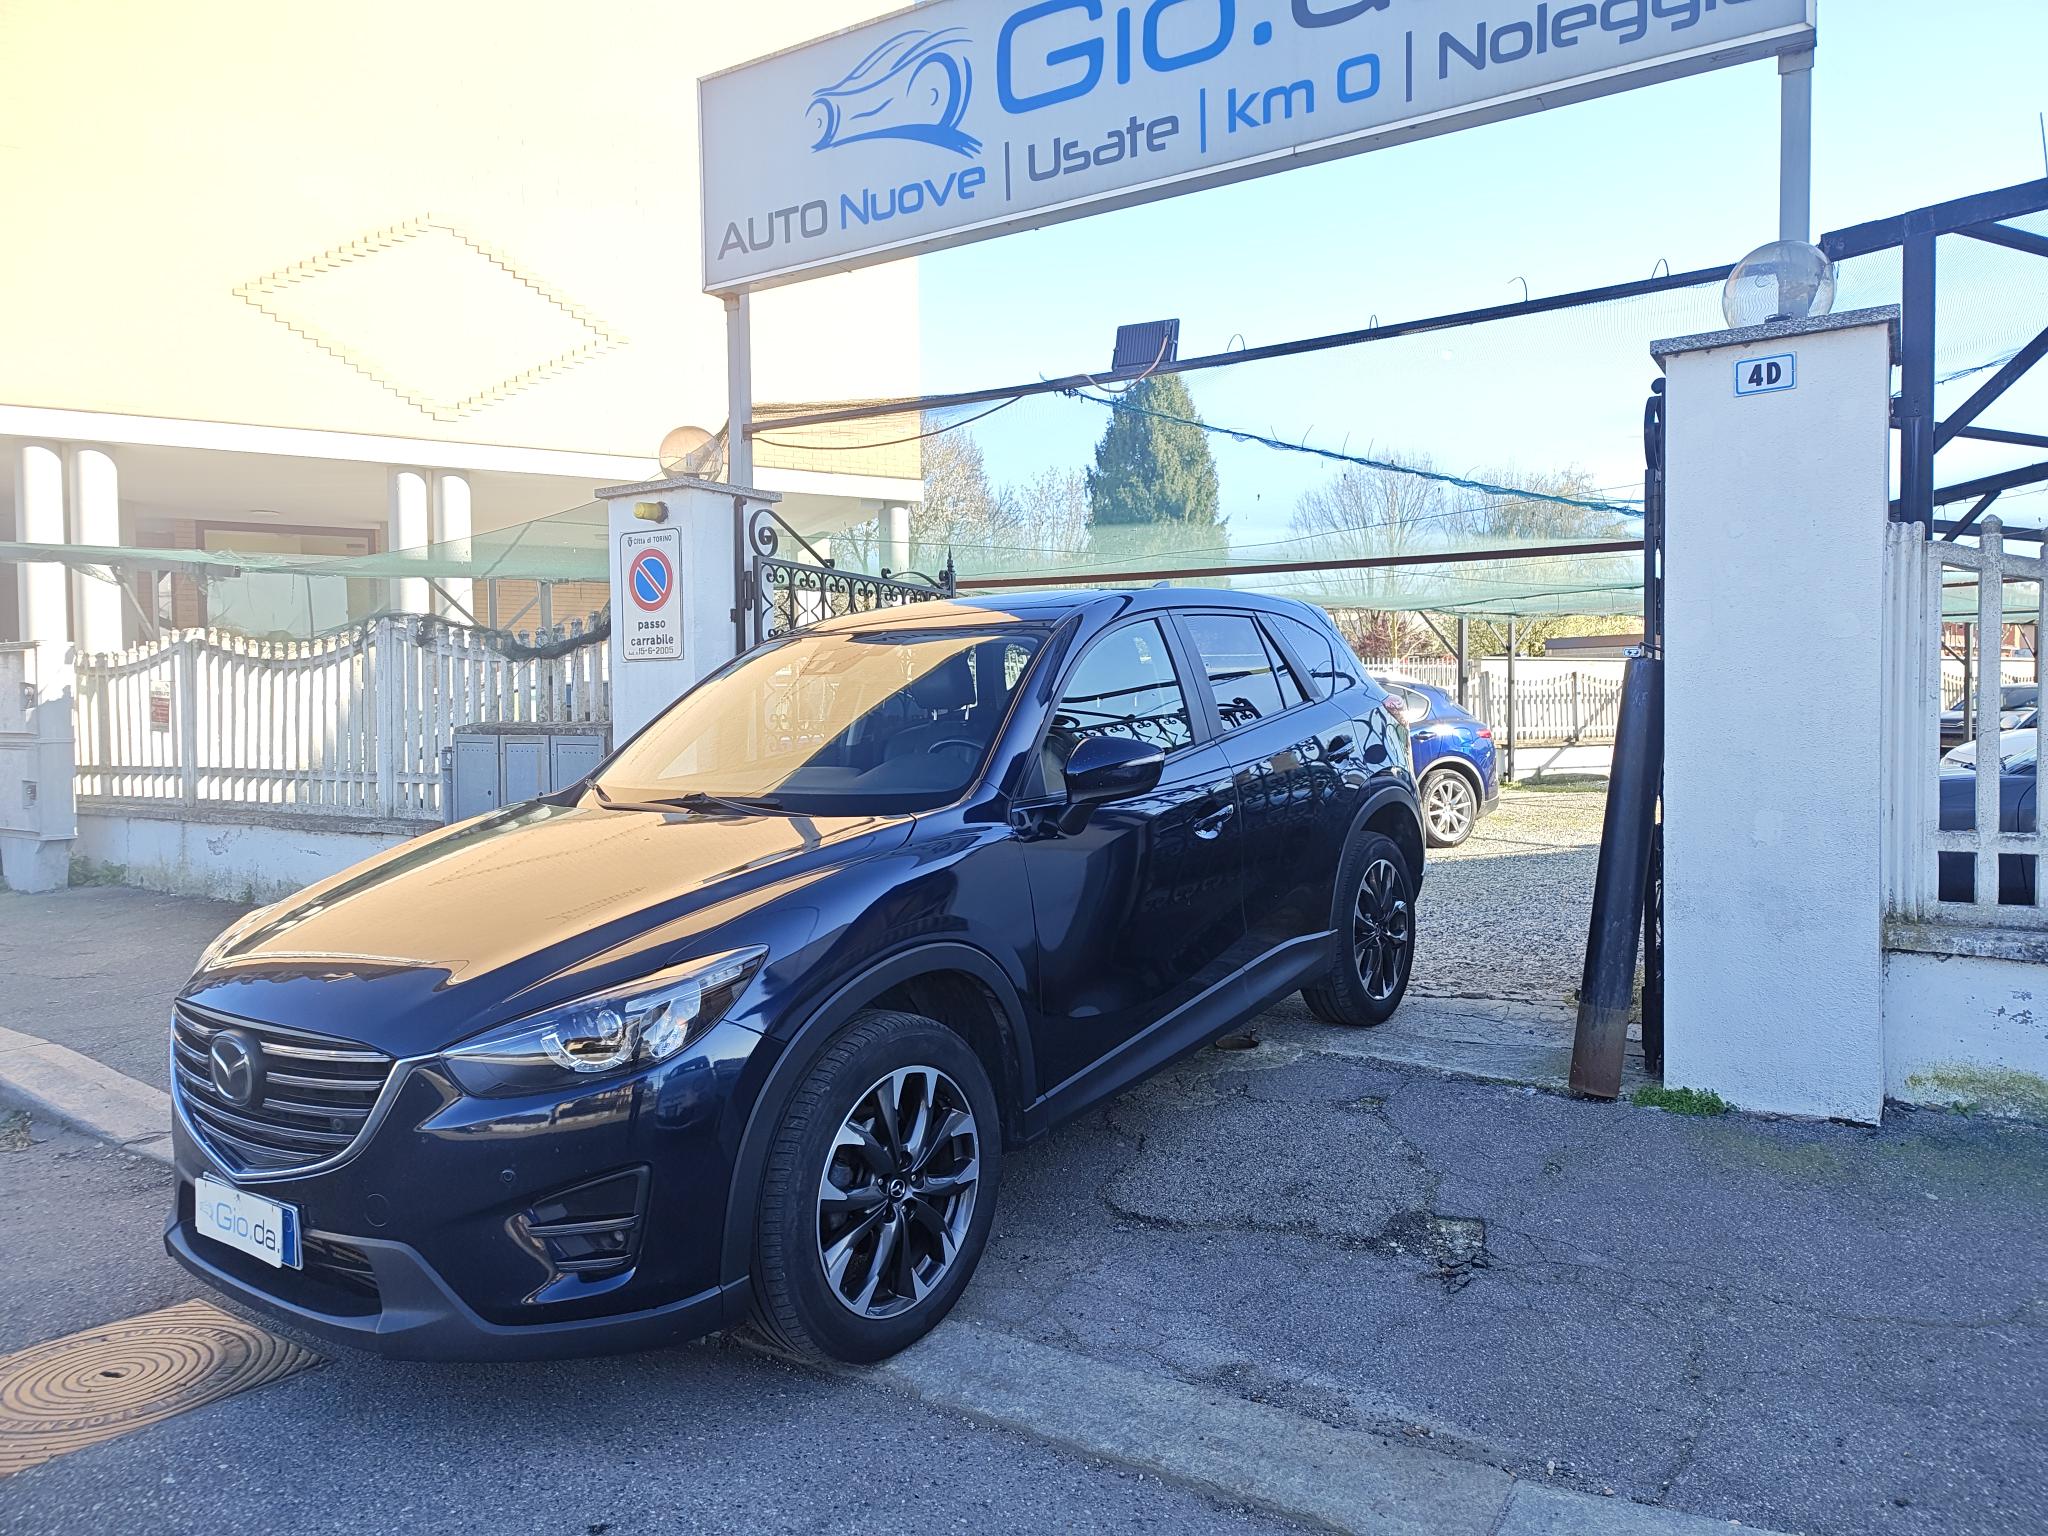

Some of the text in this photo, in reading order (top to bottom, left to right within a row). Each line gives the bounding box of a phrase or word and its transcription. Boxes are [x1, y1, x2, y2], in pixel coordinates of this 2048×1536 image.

[717, 199, 829, 260] AUTO
[840, 165, 987, 230] Nuove
[1027, 115, 1180, 183] Usate
[1228, 79, 1315, 134] km
[1438, 0, 1748, 80] Nolegg
[1748, 361, 1782, 387] 4D
[652, 534, 672, 544] TORINO
[637, 620, 666, 632] passo
[630, 633, 674, 646] carrabile
